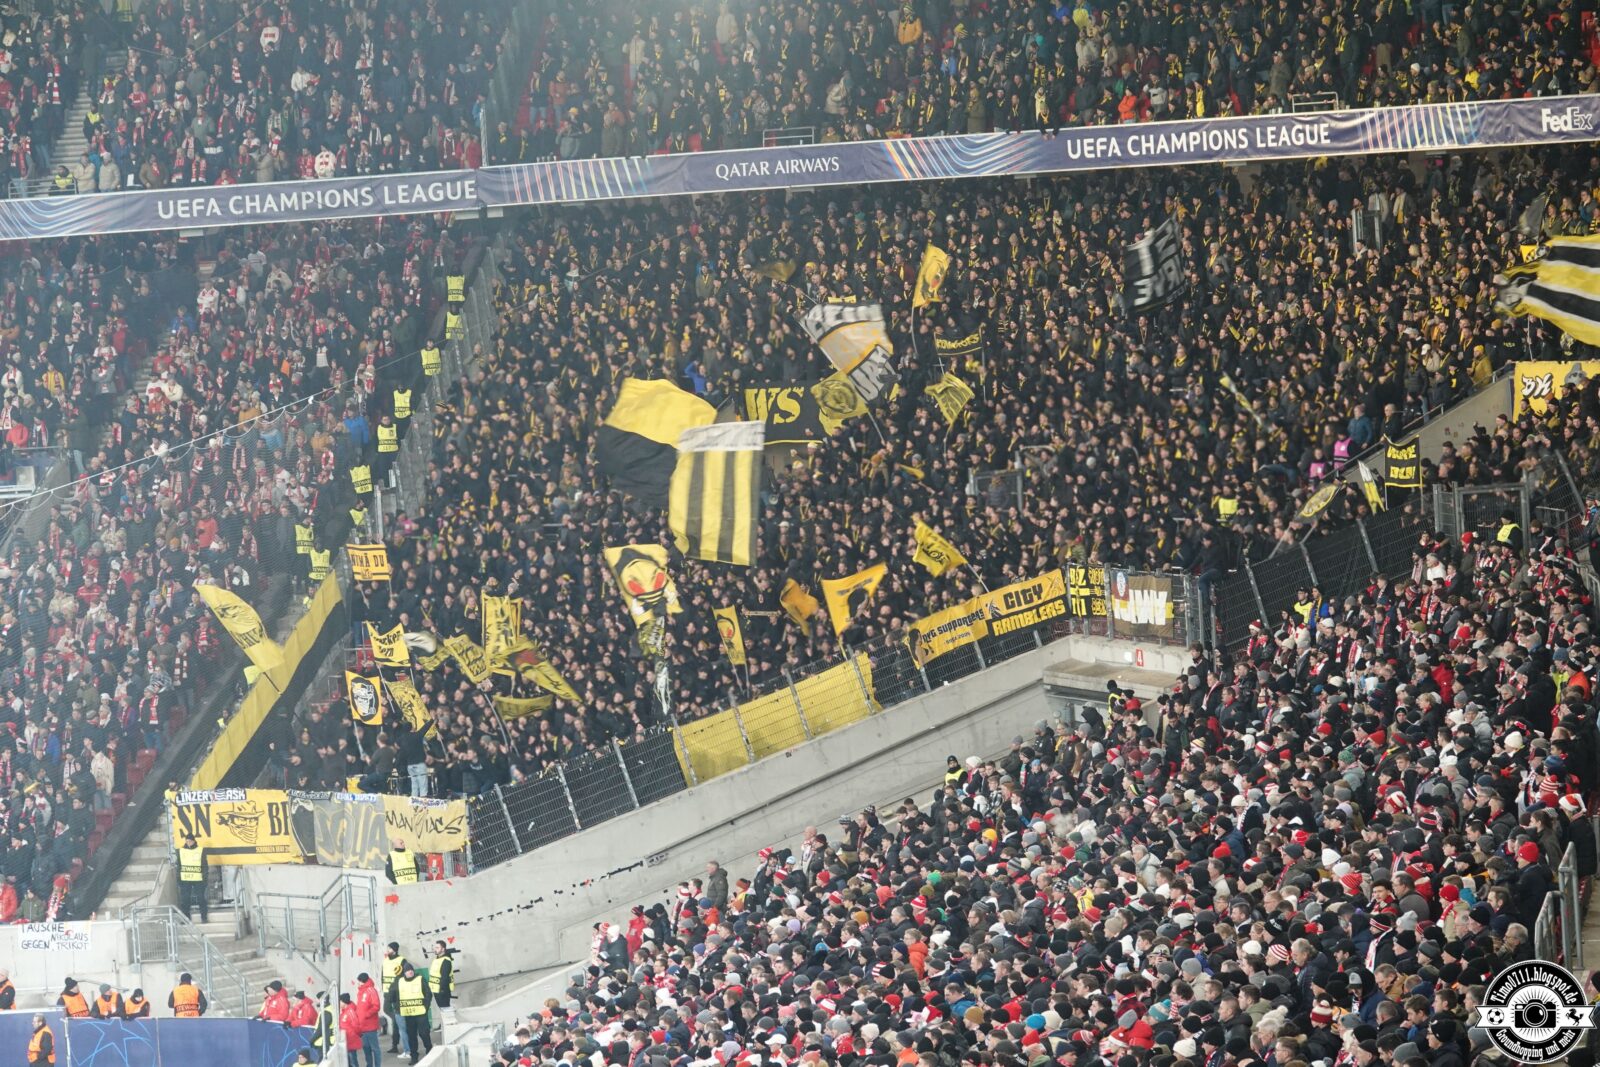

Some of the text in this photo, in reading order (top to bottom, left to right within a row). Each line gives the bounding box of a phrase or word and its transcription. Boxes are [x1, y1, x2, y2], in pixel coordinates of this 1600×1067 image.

[1541, 106, 1593, 132] FedEx
[1066, 123, 1331, 160] UEFA CHAMPIONS LEAGUE
[715, 156, 840, 181] QATAR AIRWAYS
[158, 180, 478, 220] UEFA CHAMPIONS LEAGUE
[1003, 584, 1043, 610] CITY
[992, 600, 1066, 636] RAMBLERS
[176, 789, 247, 804] LINZER ASK
[21, 940, 89, 950] GEGEN TRIKOT
